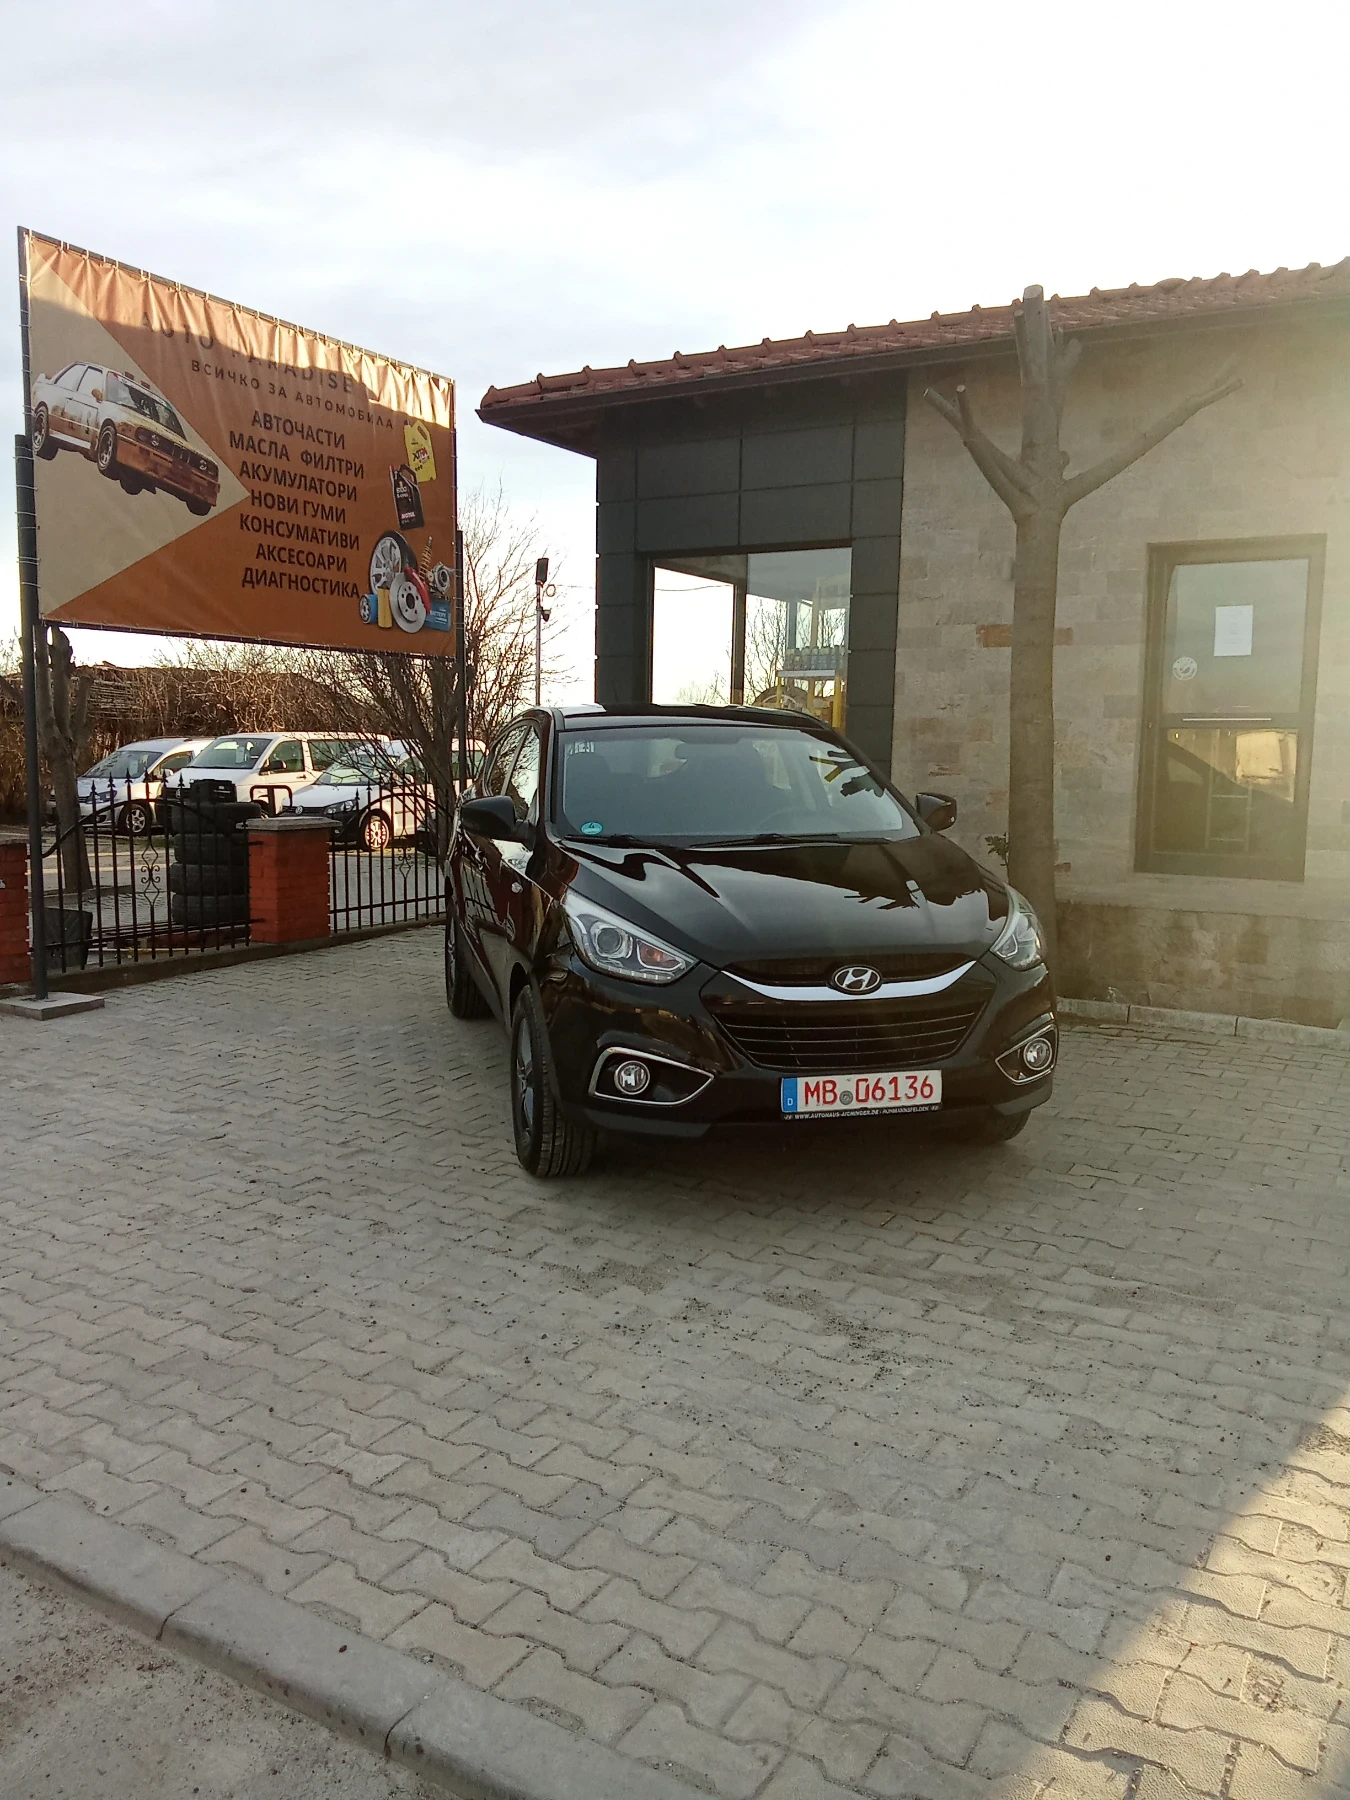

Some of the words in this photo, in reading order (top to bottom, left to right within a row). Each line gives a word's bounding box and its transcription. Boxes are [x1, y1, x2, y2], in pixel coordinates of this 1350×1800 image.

[190, 358, 261, 390] ВСИЧКО
[267, 381, 288, 400] ЗА
[295, 390, 394, 430] АВТОМОБИЛА
[251, 410, 346, 450] АВТОЧАСТИ
[229, 430, 290, 462] МАСЛА
[300, 449, 365, 480] ФИЛТРИ
[239, 460, 358, 503] АКУМУЛАТОРИ
[250, 489, 298, 516] НОВИ
[303, 502, 346, 525] ГУМИ
[239, 512, 360, 551] КОНСУМАТИВИ
[255, 542, 347, 573] АКСЕСОАРИ
[241, 567, 360, 599] ДИАГНОСТИКА
[787, 1097, 793, 1106] D
[804, 1080, 837, 1105] MB
[855, 1075, 934, 1102] 06136
